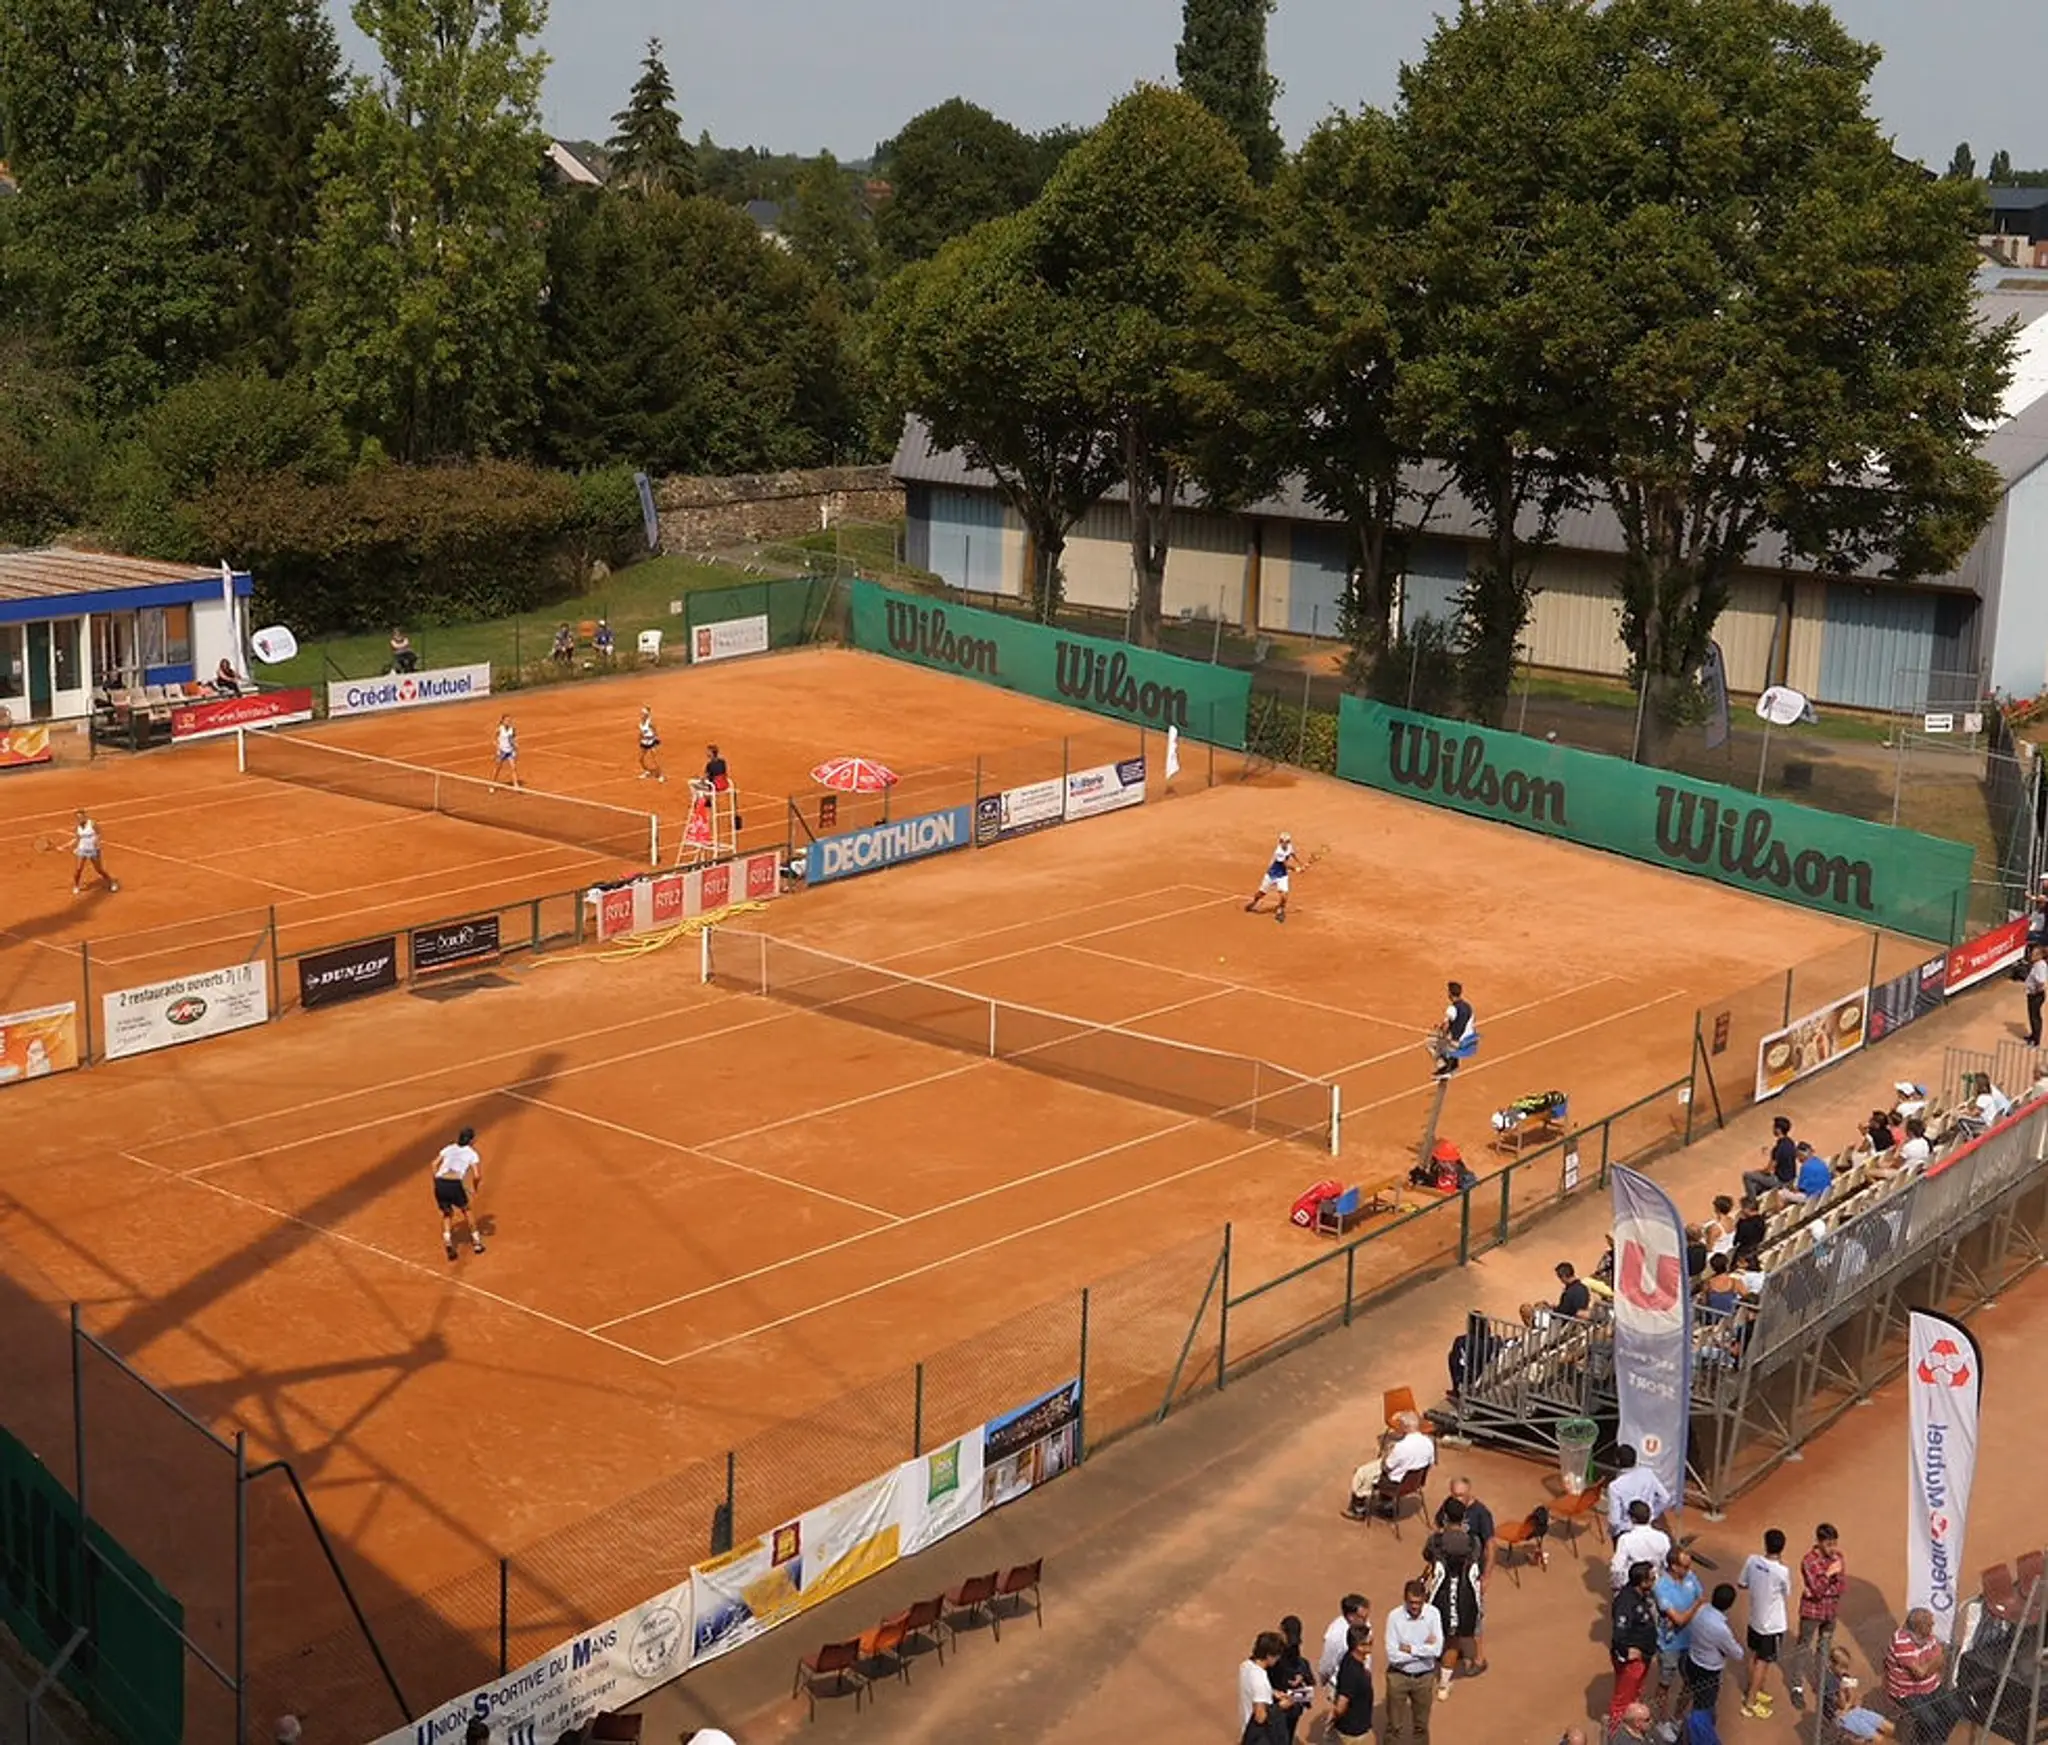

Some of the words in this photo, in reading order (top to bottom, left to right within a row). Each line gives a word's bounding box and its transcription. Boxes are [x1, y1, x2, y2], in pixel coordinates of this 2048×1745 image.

[884, 599, 999, 676] Wilson
[346, 684, 398, 708] Crédit
[418, 674, 471, 697] Mutuel
[1055, 640, 1188, 728] Wilson
[1386, 719, 1568, 827] Wilson
[822, 812, 955, 876] DECATHLON
[1655, 785, 1875, 910] Wilson
[120, 992, 126, 1008] 2
[129, 982, 185, 1005] restaurants
[320, 957, 390, 985] DUNLOP
[417, 1708, 468, 1745] UNION
[473, 1666, 545, 1720] SPORTIVE
[549, 1655, 570, 1678] DU
[572, 1630, 617, 1670] MANS
